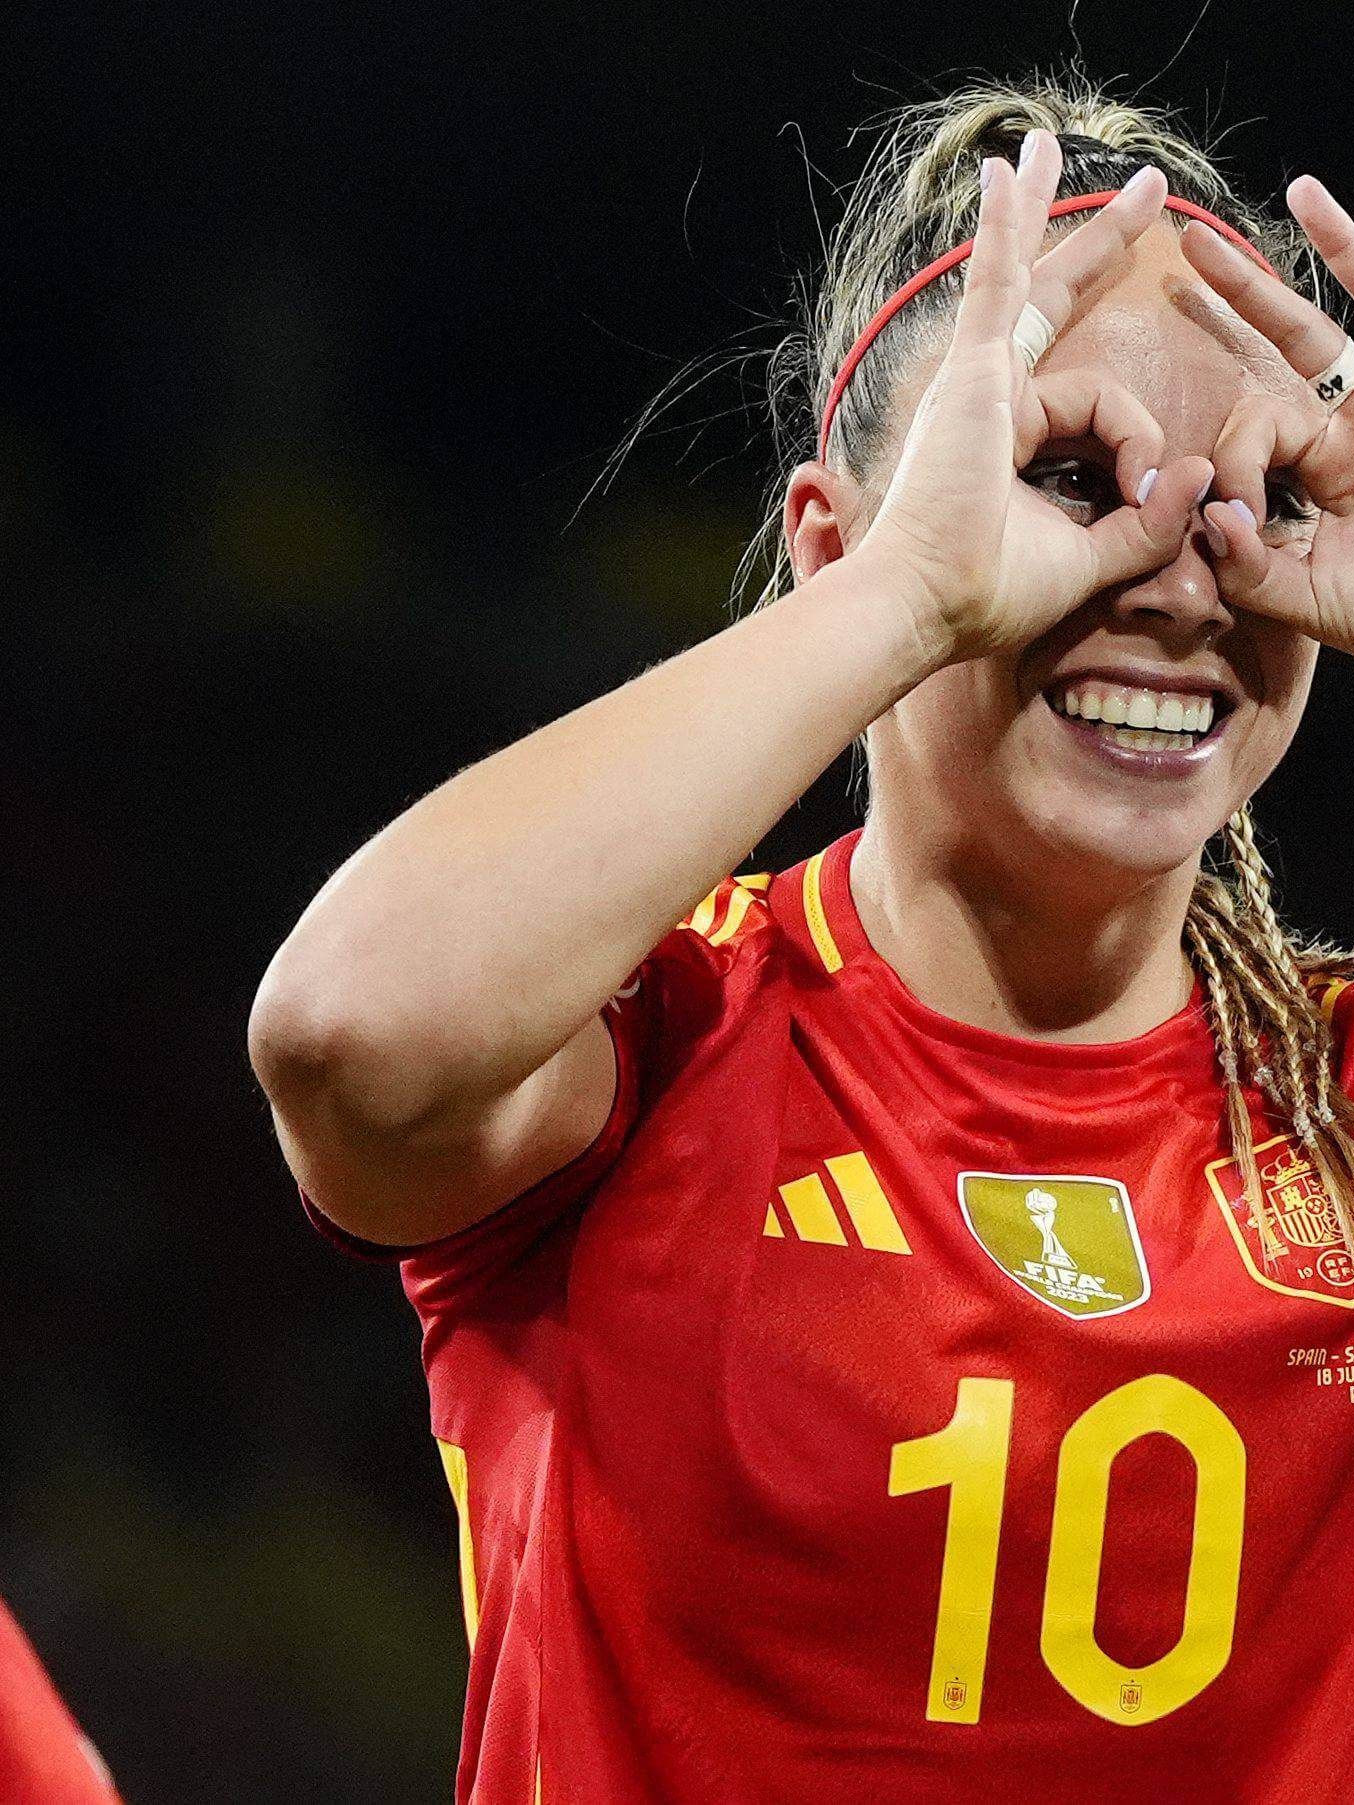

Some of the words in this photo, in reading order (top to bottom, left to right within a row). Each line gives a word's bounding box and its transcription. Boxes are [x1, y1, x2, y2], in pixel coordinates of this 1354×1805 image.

[1023, 1260, 1105, 1292] FIFA
[1286, 1348, 1328, 1367] SPAIN
[1316, 1367, 1333, 1387] 18
[888, 1373, 1247, 1727] 10
